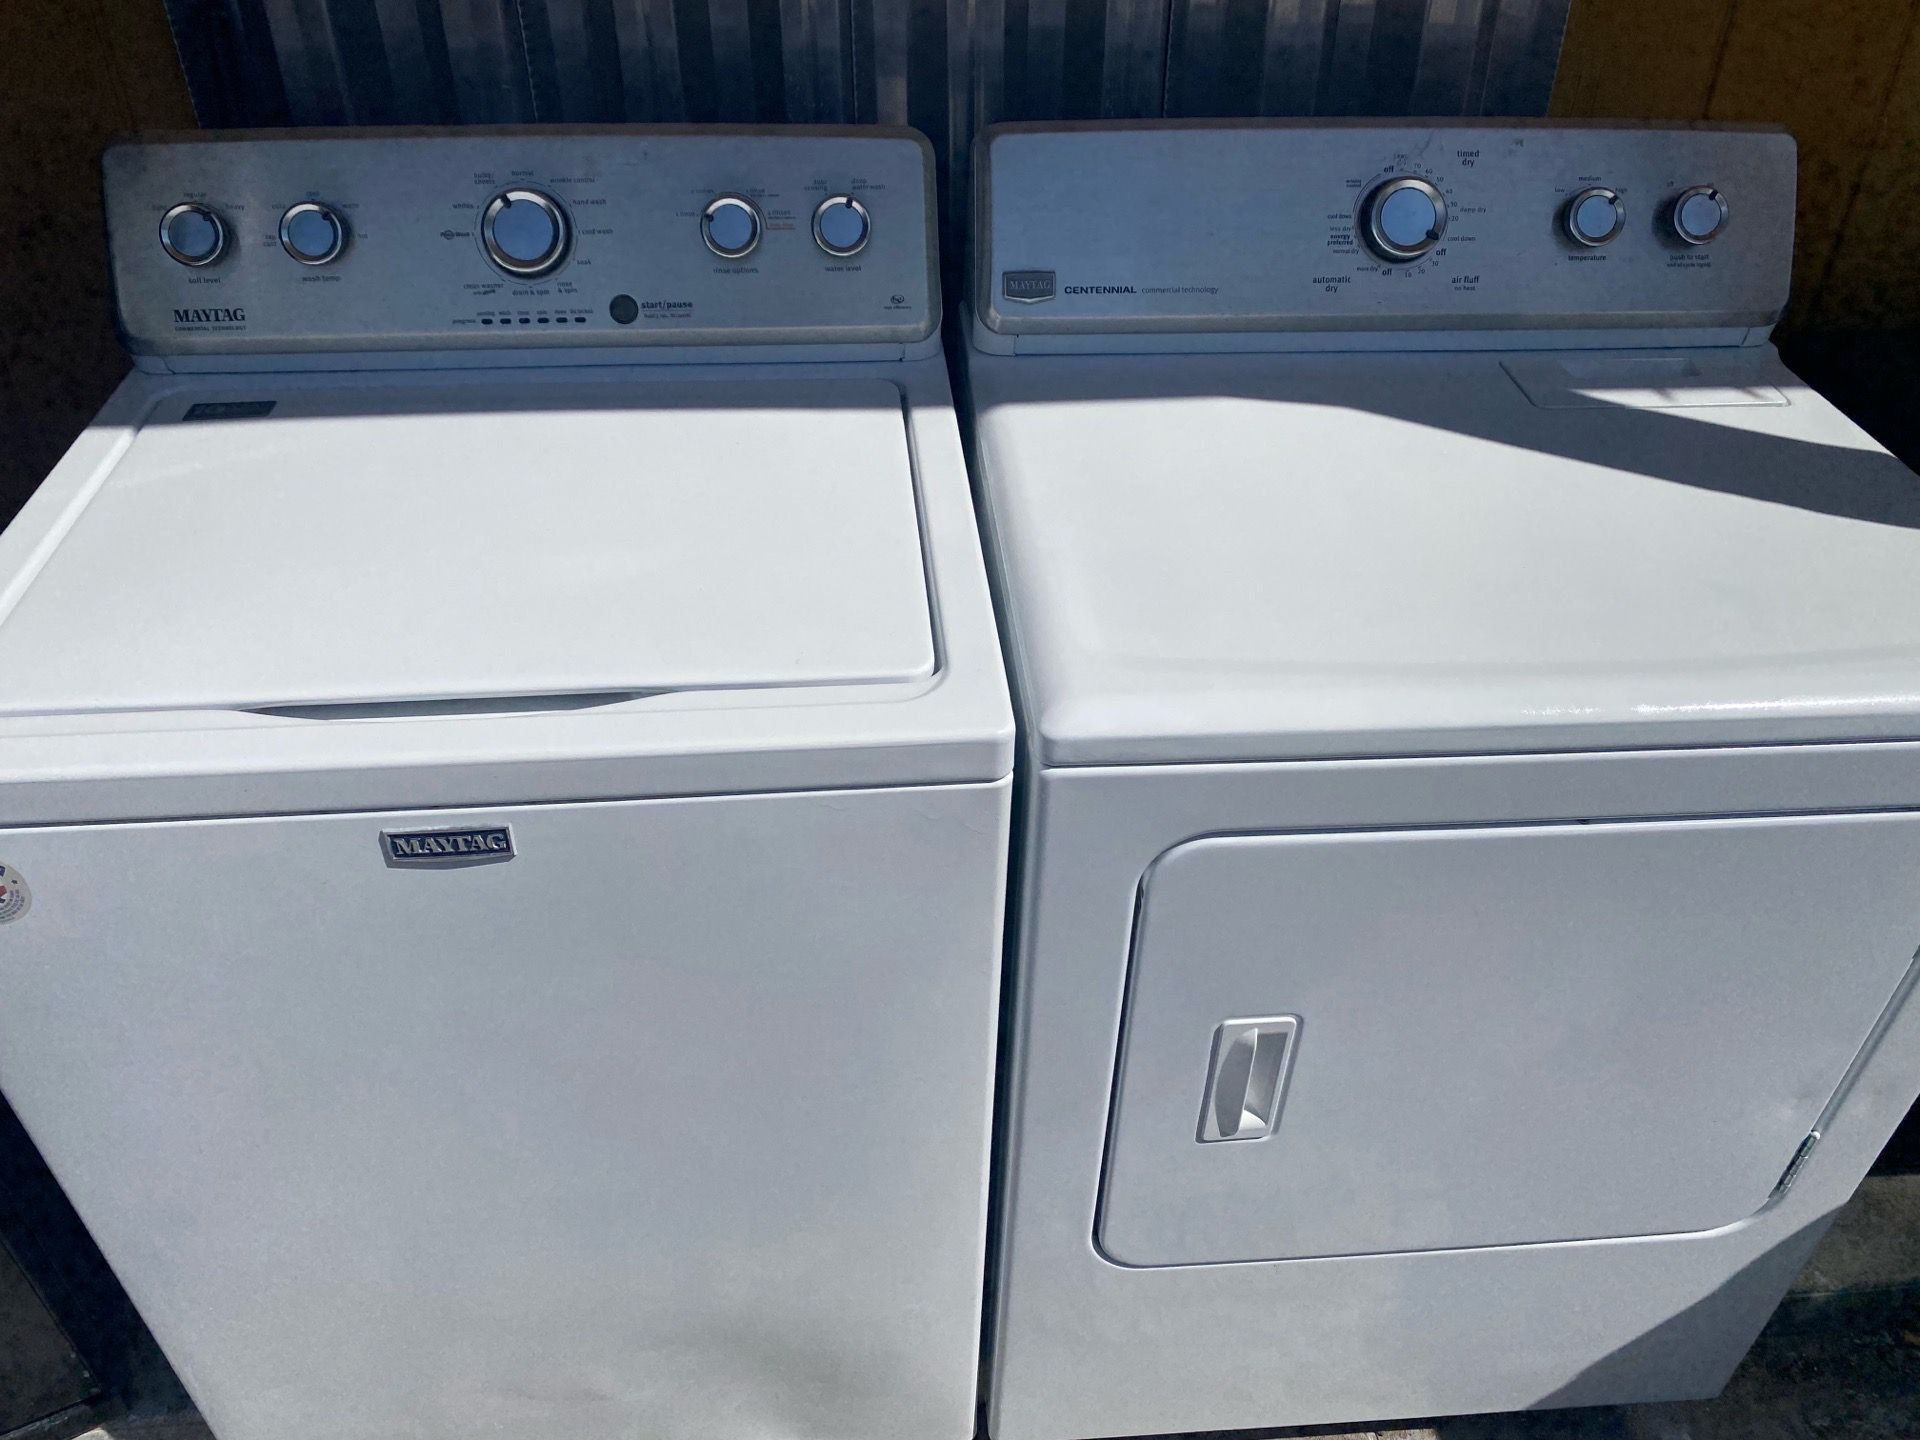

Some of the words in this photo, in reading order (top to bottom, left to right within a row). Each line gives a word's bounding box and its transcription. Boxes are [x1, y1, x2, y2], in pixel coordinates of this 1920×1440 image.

[1457, 149, 1480, 157] timed
[1461, 158, 1475, 168] dry
[1383, 165, 1394, 173] off
[1477, 206, 1487, 214] dry
[1435, 248, 1447, 256] off
[1568, 255, 1607, 263] temperature
[732, 267, 759, 275] options
[1382, 268, 1393, 276] off
[1312, 276, 1351, 284] automatic
[1463, 275, 1480, 284] fluff
[1009, 279, 1051, 290] MAYTAG
[1325, 284, 1339, 293] dry
[537, 289, 550, 297] spin
[1064, 285, 1137, 295] CENTENNIAL
[1141, 286, 1180, 294] commercial
[1181, 285, 1219, 296] technology
[641, 300, 693, 311] start/pause
[173, 308, 246, 323] MAYTAG
[393, 833, 507, 855] MAYTAG
